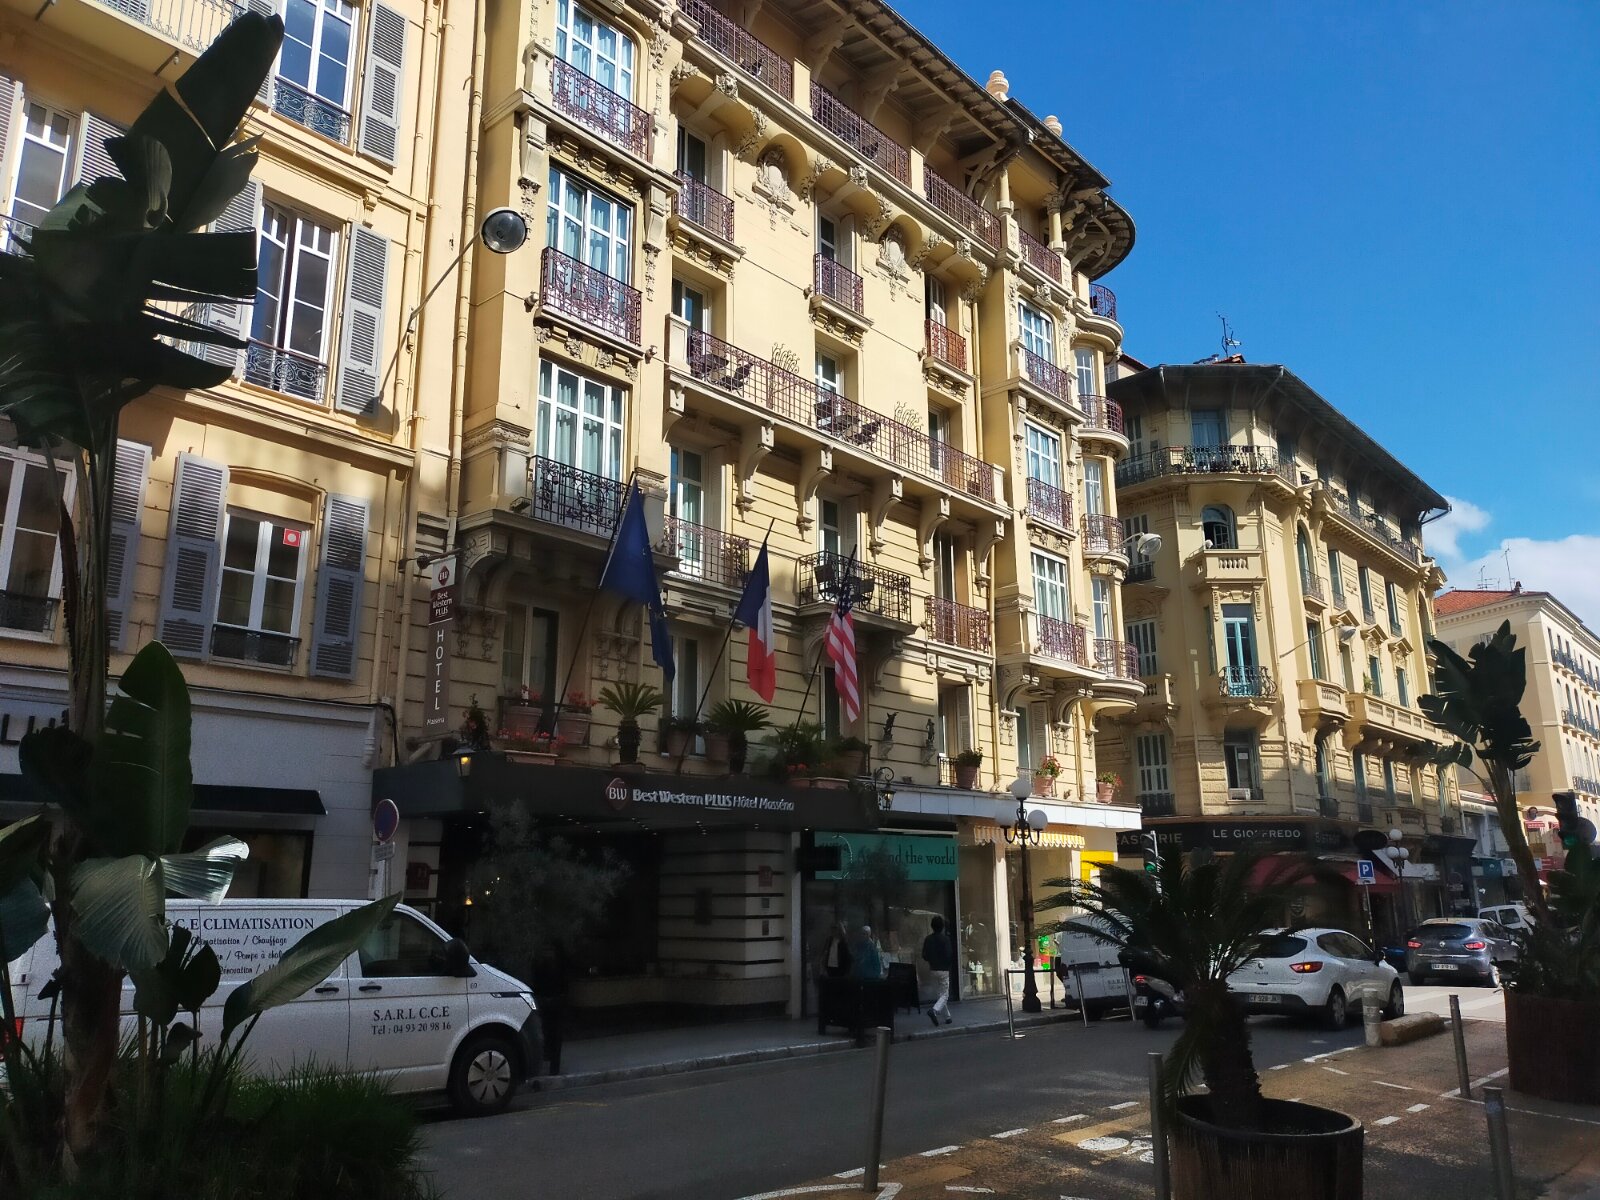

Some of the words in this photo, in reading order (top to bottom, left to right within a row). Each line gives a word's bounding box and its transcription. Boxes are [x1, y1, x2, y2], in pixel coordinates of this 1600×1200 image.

[437, 592, 449, 600] Best
[432, 598, 453, 609] Western
[435, 607, 449, 616] PLUS
[434, 629, 444, 710] HOTEL
[608, 787, 627, 800] BW
[632, 788, 658, 802] Best
[658, 790, 704, 805] Western
[704, 793, 732, 808] PLUS
[733, 797, 758, 808] Hôtel
[759, 798, 795, 811] Masséna
[1212, 829, 1228, 838] LE
[905, 845, 923, 864] the
[925, 847, 956, 865] world
[1362, 864, 1370, 875] P
[203, 917, 314, 930] CLIMATISATION
[251, 935, 287, 946] Chauffage
[234, 952, 259, 961] Pompe
[373, 1008, 416, 1022] S.A.R.L
[419, 1006, 450, 1019] C.C.E
[393, 1024, 403, 1034] 04
[405, 1023, 416, 1033] 93
[418, 1023, 428, 1032] 20
[430, 1022, 440, 1031] 98
[442, 1021, 452, 1030] 16
